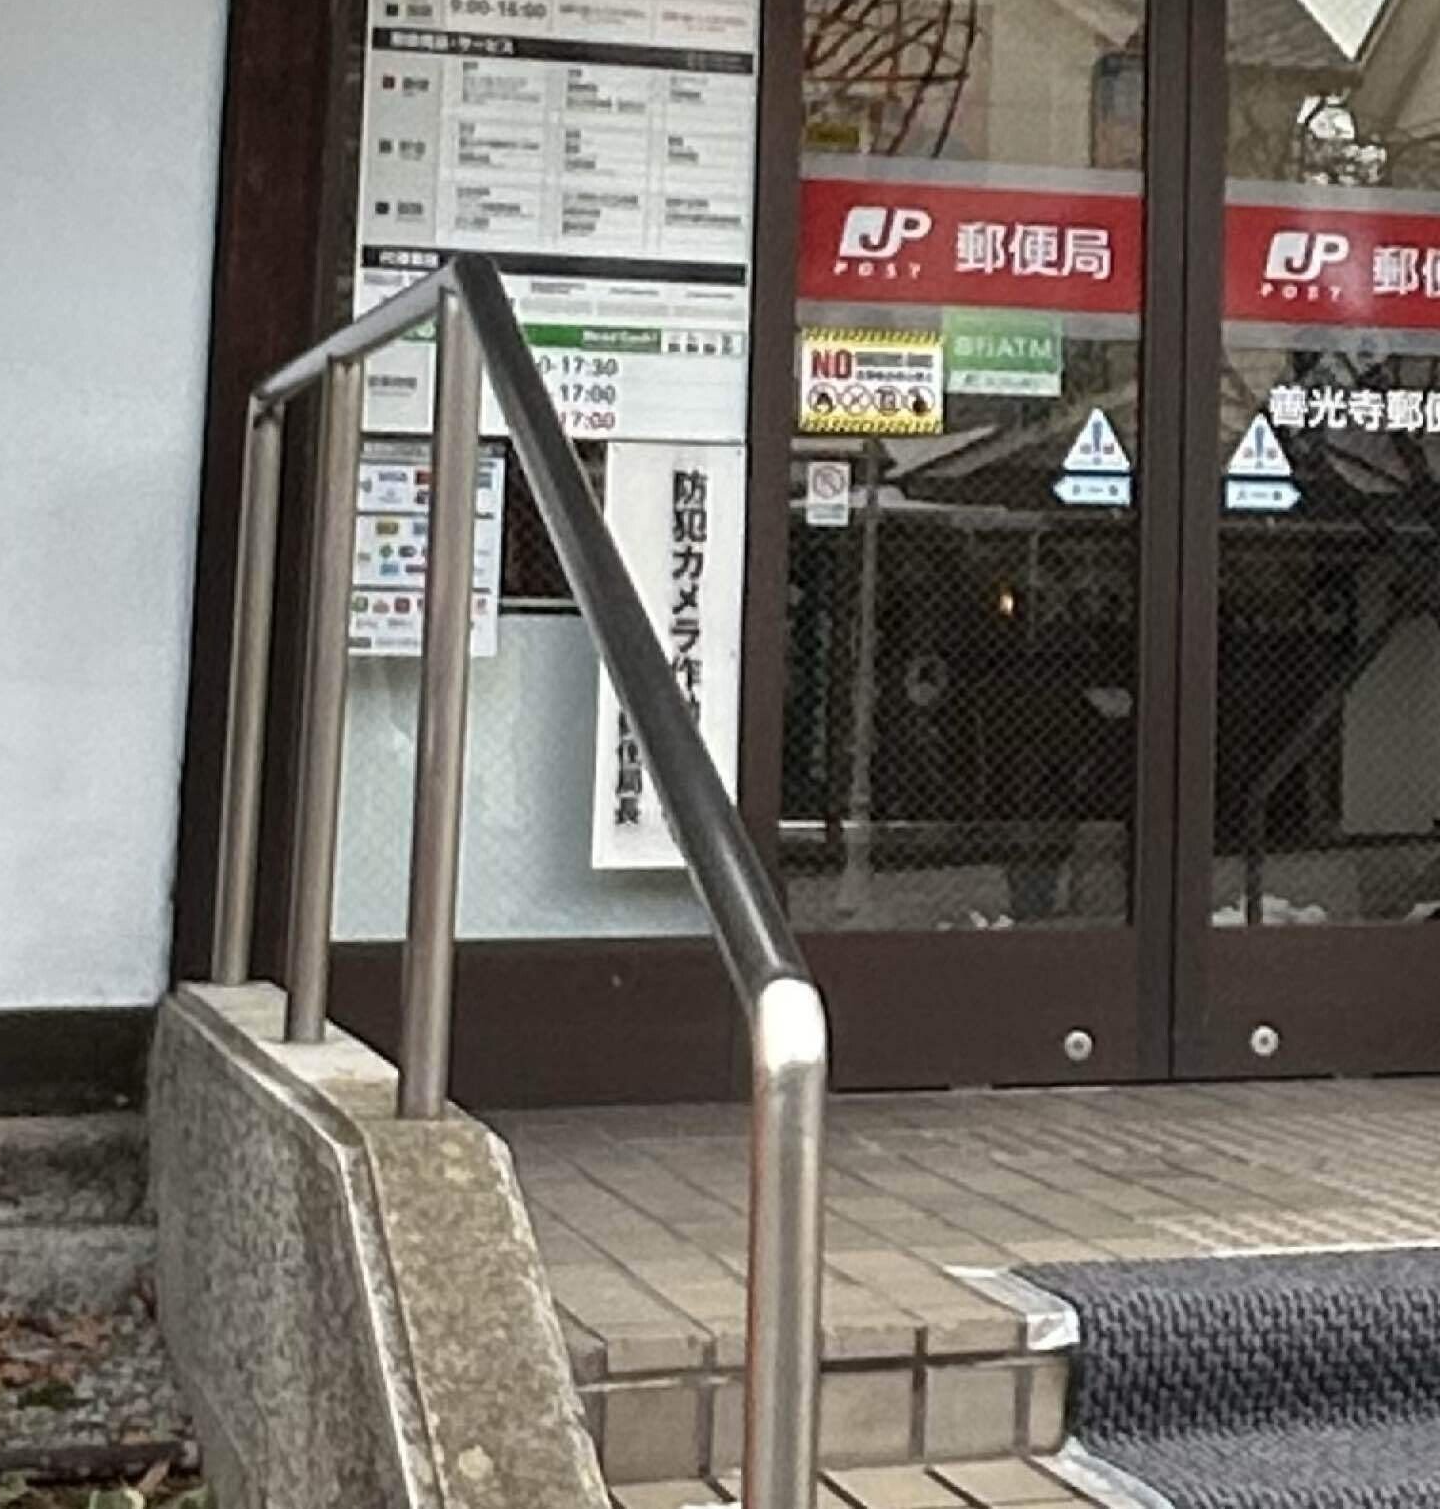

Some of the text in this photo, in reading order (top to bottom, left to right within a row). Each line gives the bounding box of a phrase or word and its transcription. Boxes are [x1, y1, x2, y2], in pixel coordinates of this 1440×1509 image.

[955, 221, 1113, 281] 郵便局
[810, 349, 854, 381] NO
[670, 469, 709, 725] 防犯カメラ作
